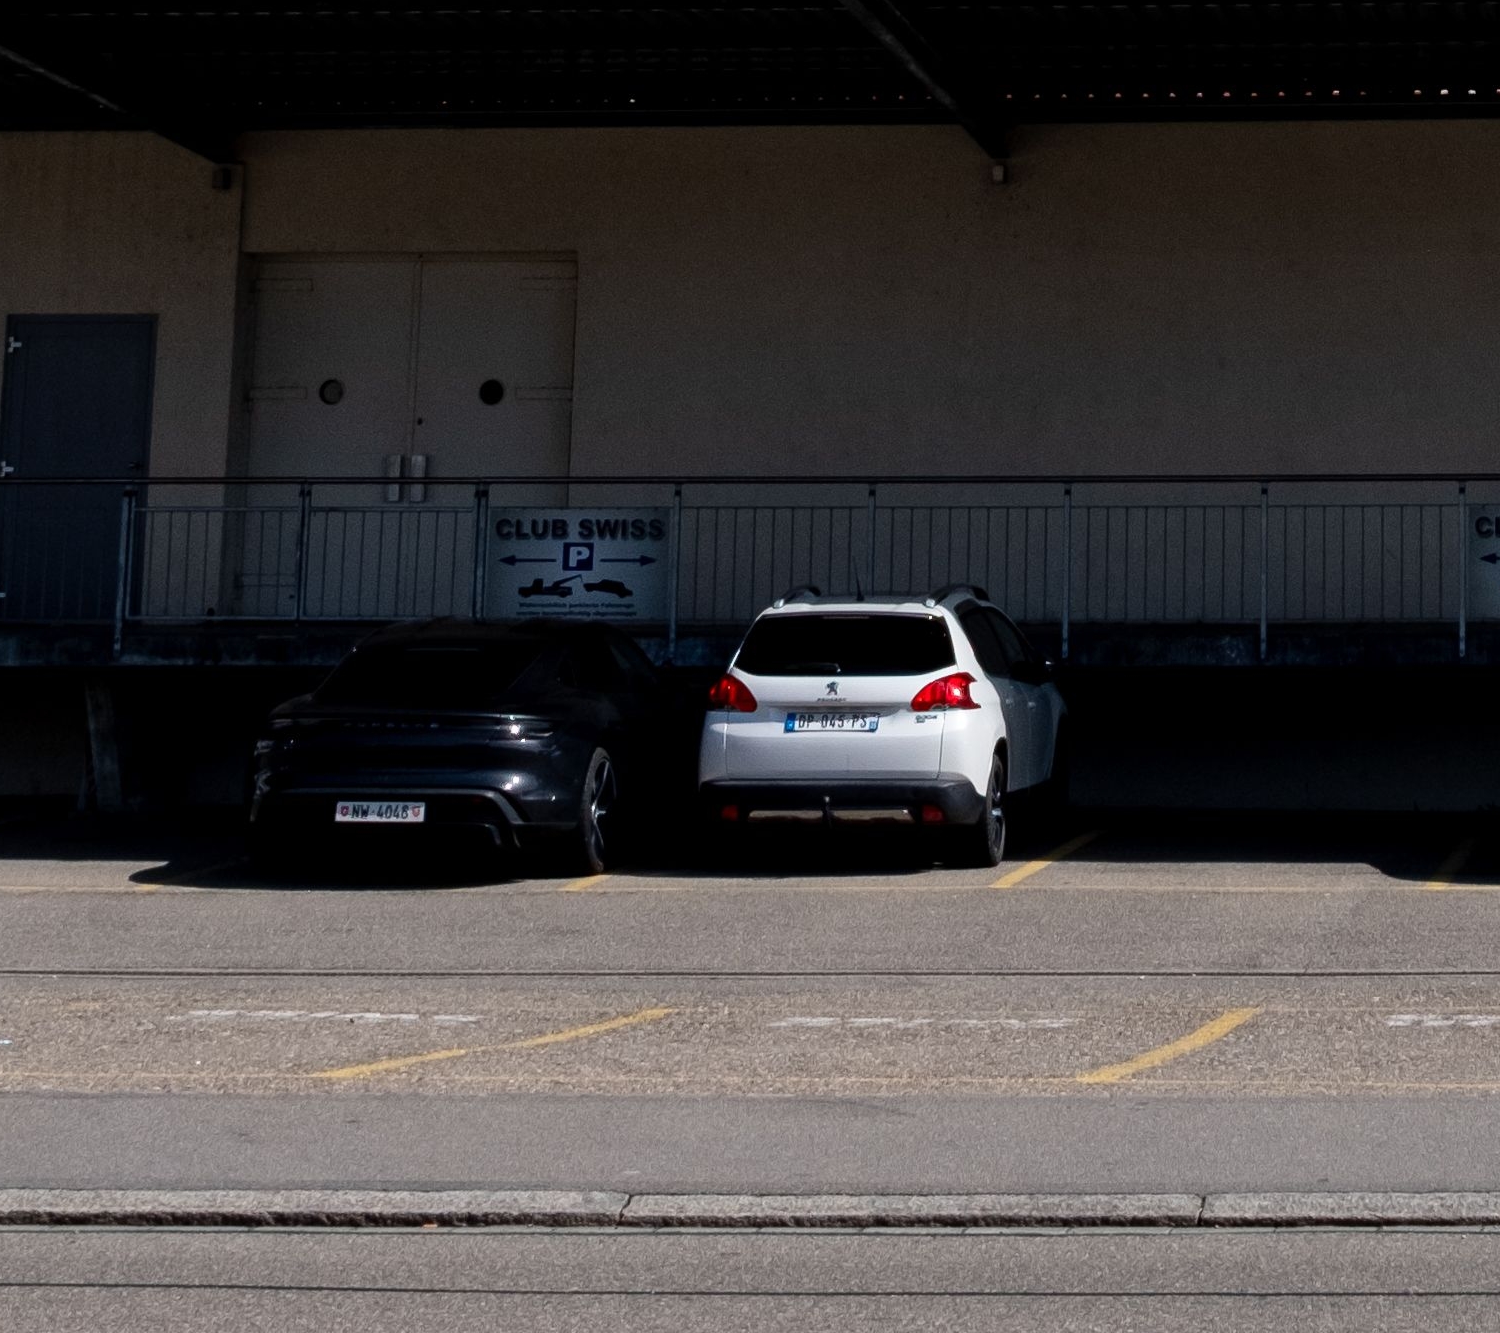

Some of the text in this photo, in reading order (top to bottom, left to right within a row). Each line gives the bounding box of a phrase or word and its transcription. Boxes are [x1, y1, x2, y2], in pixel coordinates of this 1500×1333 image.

[496, 518, 666, 540] CLUB SWISS
[569, 546, 590, 567] P
